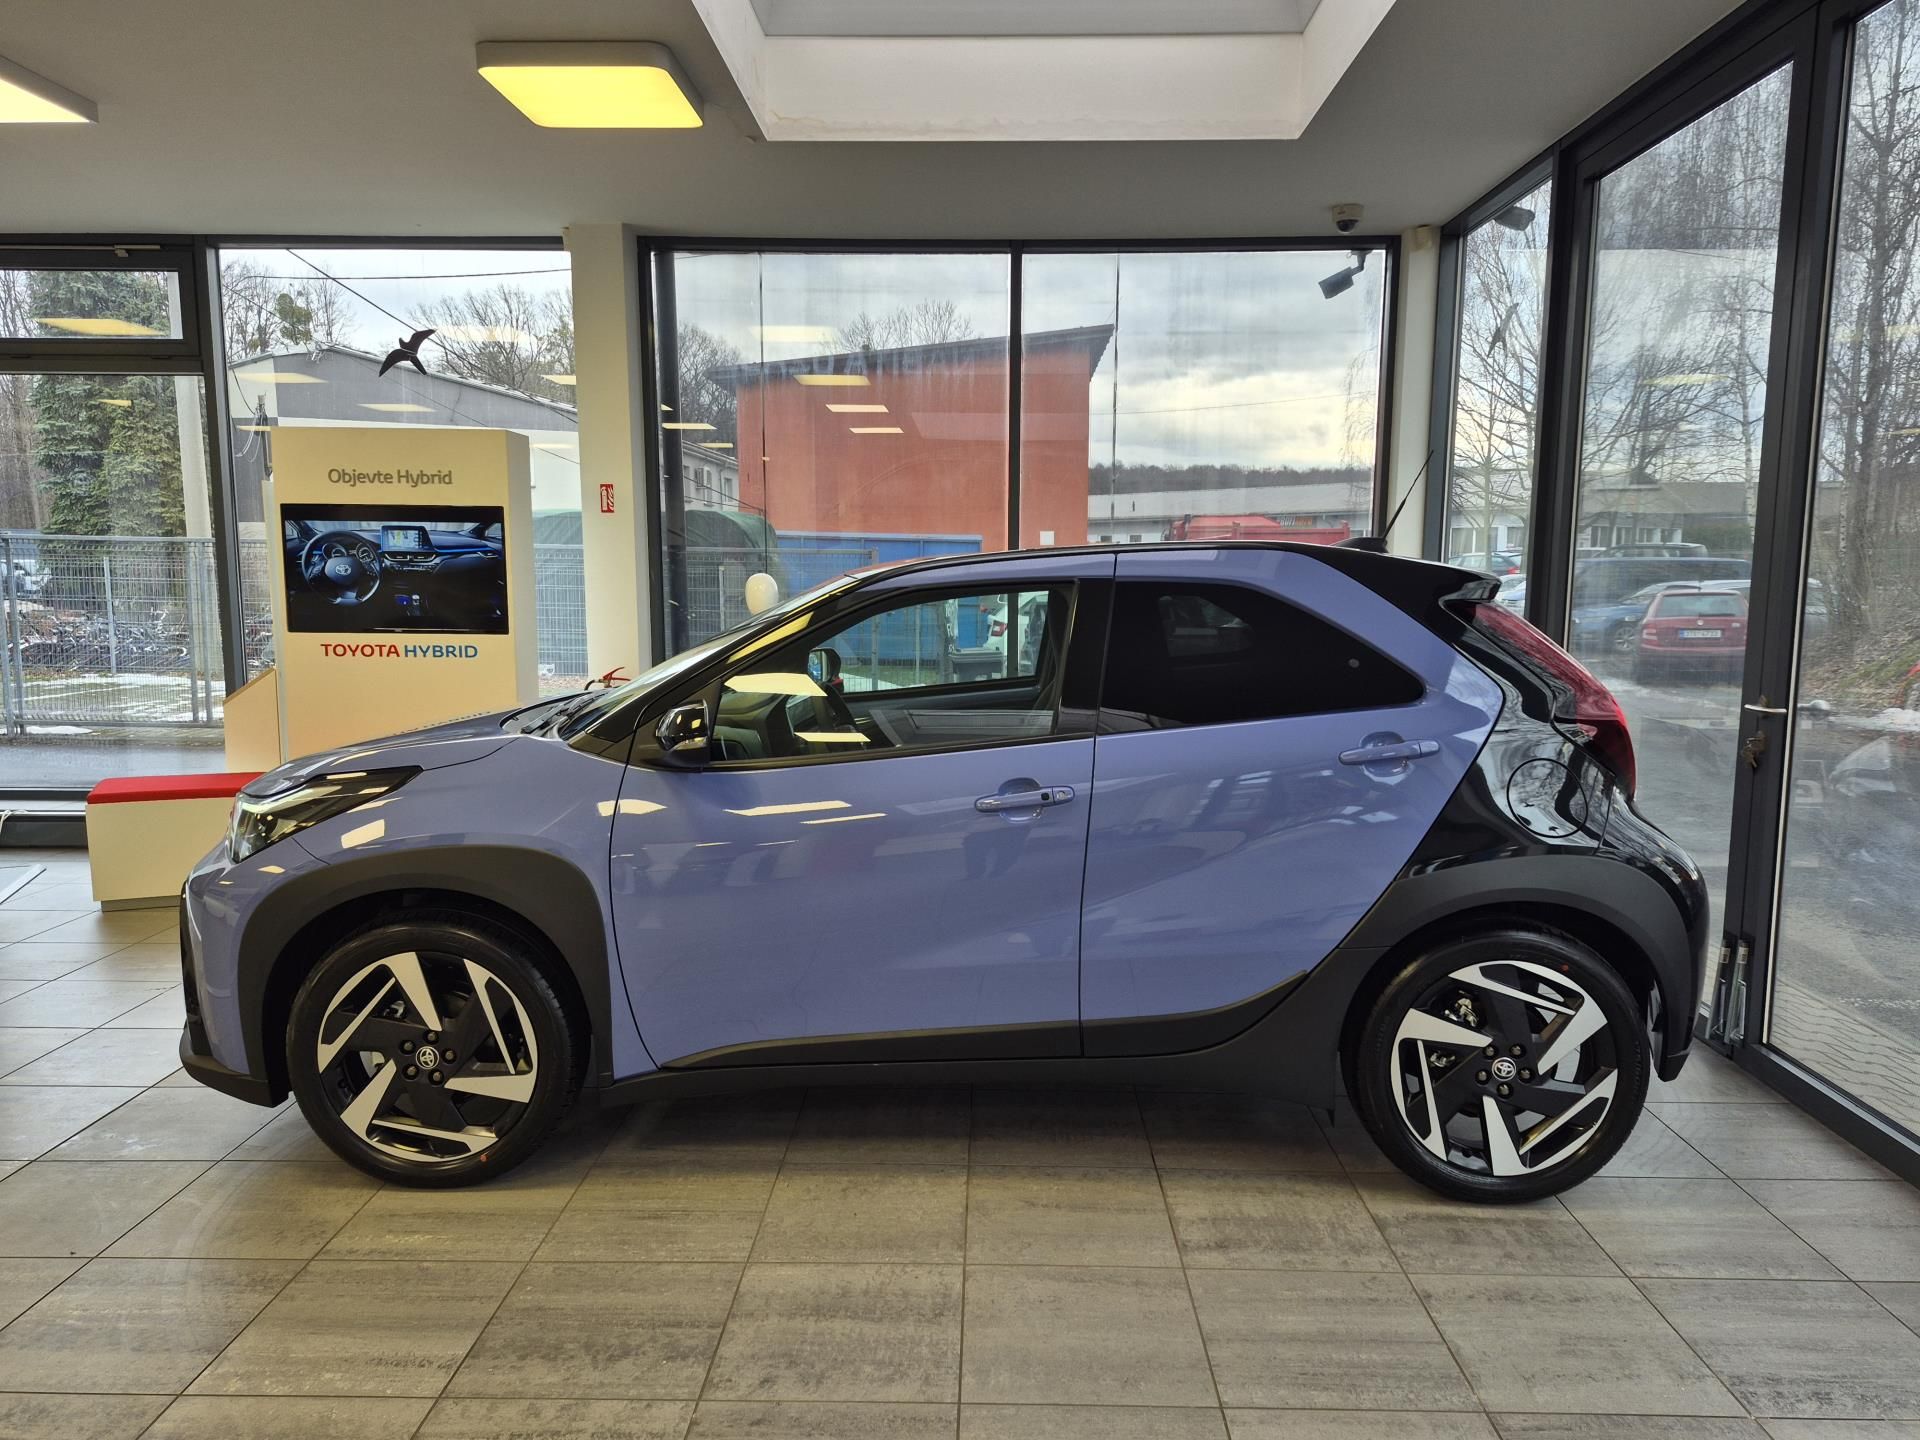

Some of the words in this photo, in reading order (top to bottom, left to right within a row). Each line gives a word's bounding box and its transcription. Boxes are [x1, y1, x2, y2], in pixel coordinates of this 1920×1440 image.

[328, 468, 394, 487] Objevte
[397, 469, 453, 488] Hybrid
[320, 643, 400, 657] TOYOTA
[404, 644, 479, 658] HYBRID
